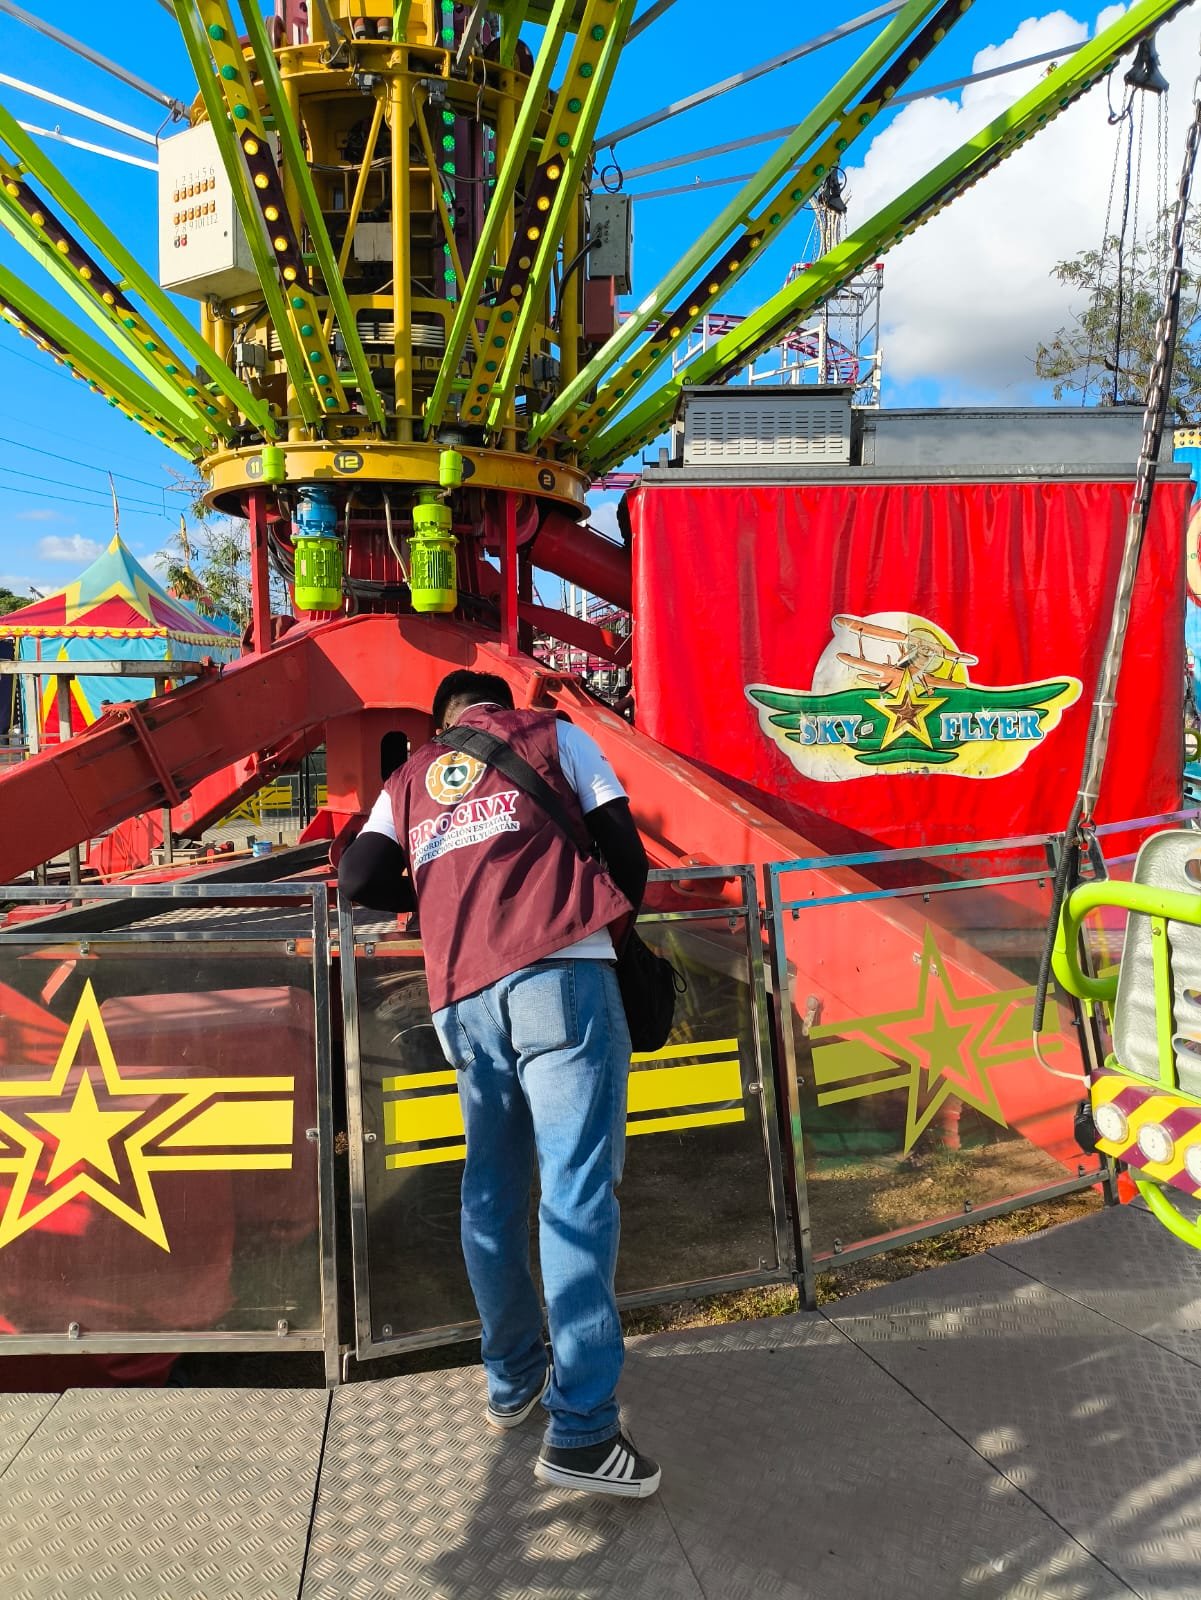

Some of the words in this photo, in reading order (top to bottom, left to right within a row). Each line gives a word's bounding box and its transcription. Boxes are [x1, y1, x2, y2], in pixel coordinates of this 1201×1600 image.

[250, 461, 260, 474] 11
[338, 455, 359, 469] 12
[543, 474, 551, 486] 2
[939, 711, 1045, 742] FLYER
[409, 791, 518, 853] PROCIVY
[473, 814, 510, 833] ESTATAL
[454, 833, 479, 847] CIVIL
[479, 821, 518, 840] YUCATÁN
